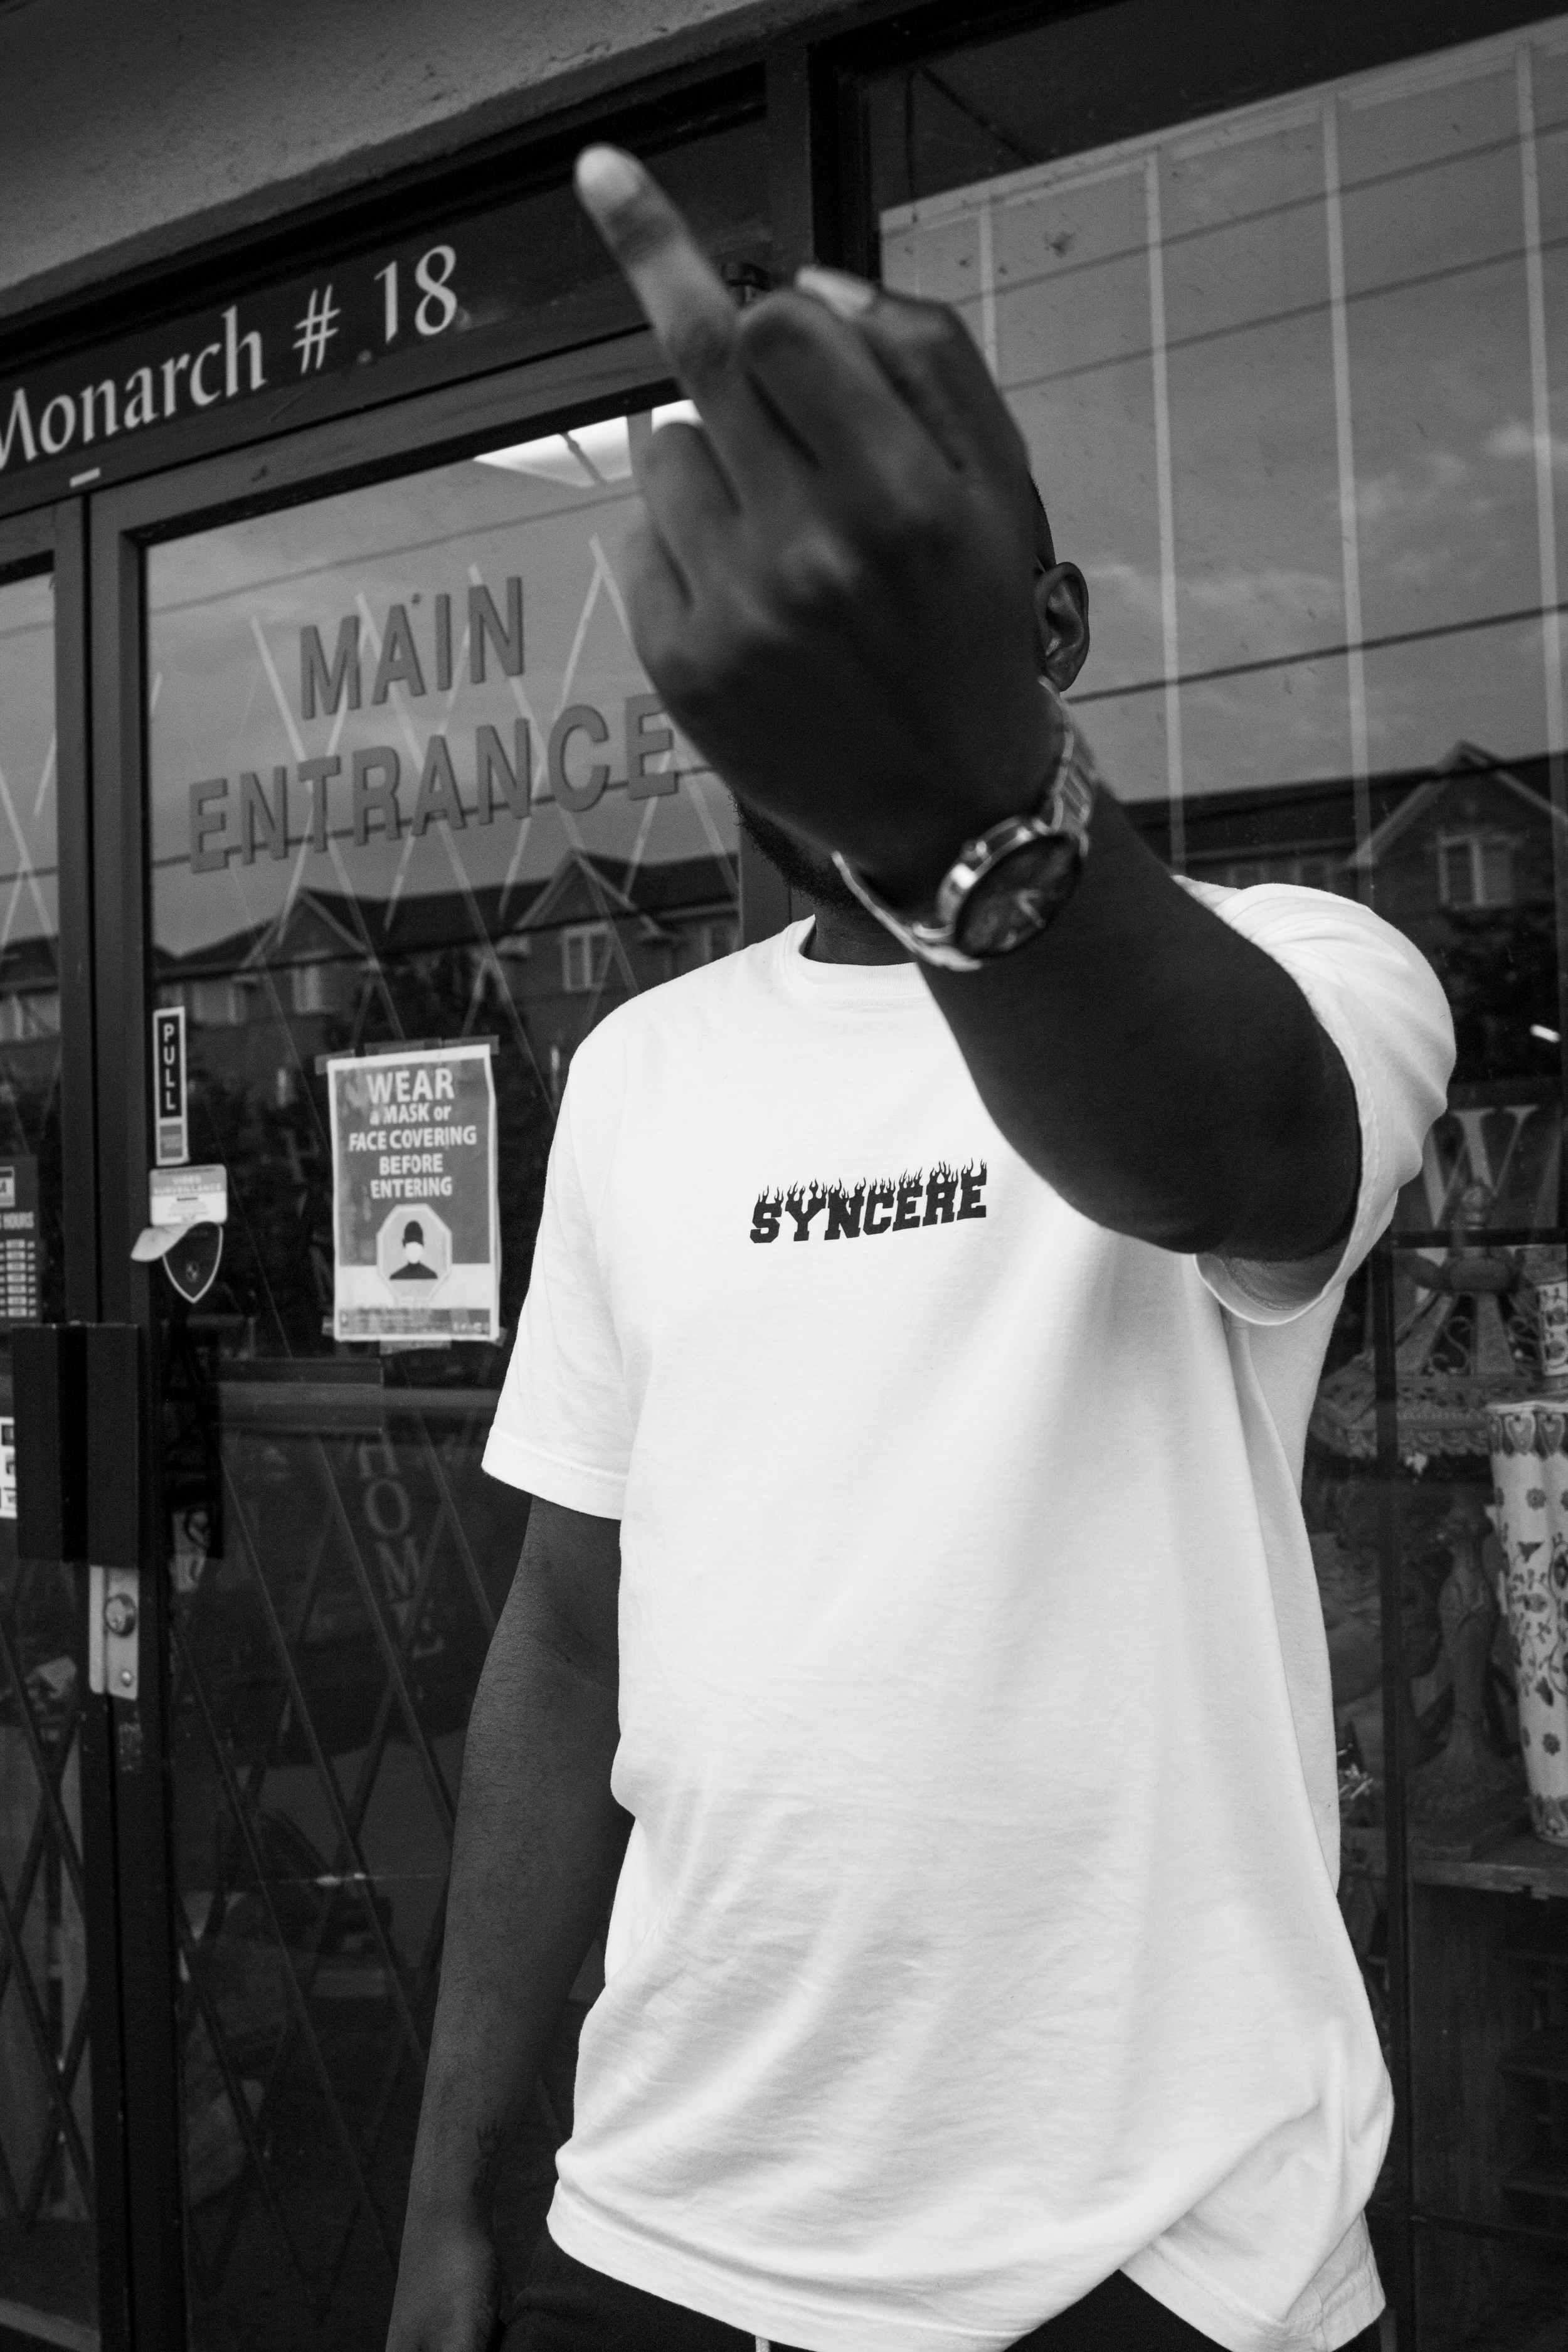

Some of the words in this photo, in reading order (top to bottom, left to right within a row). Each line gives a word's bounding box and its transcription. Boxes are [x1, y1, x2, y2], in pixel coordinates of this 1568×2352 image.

[292, 283, 341, 374] #
[374, 245, 458, 343] 18
[299, 576, 524, 721] MAIN
[188, 693, 679, 874] ENTRANCE
[162, 1022, 176, 1111] PULL
[366, 1067, 455, 1104] WEAR
[349, 1130, 387, 1152] FACE
[389, 1125, 477, 1149] COVERING
[383, 1102, 430, 1125] MASK
[433, 1105, 452, 1121] or
[370, 1175, 453, 1199] ENTERING
[379, 1152, 444, 1176] BEFORE
[750, 1158, 988, 1243] SYNCERE
